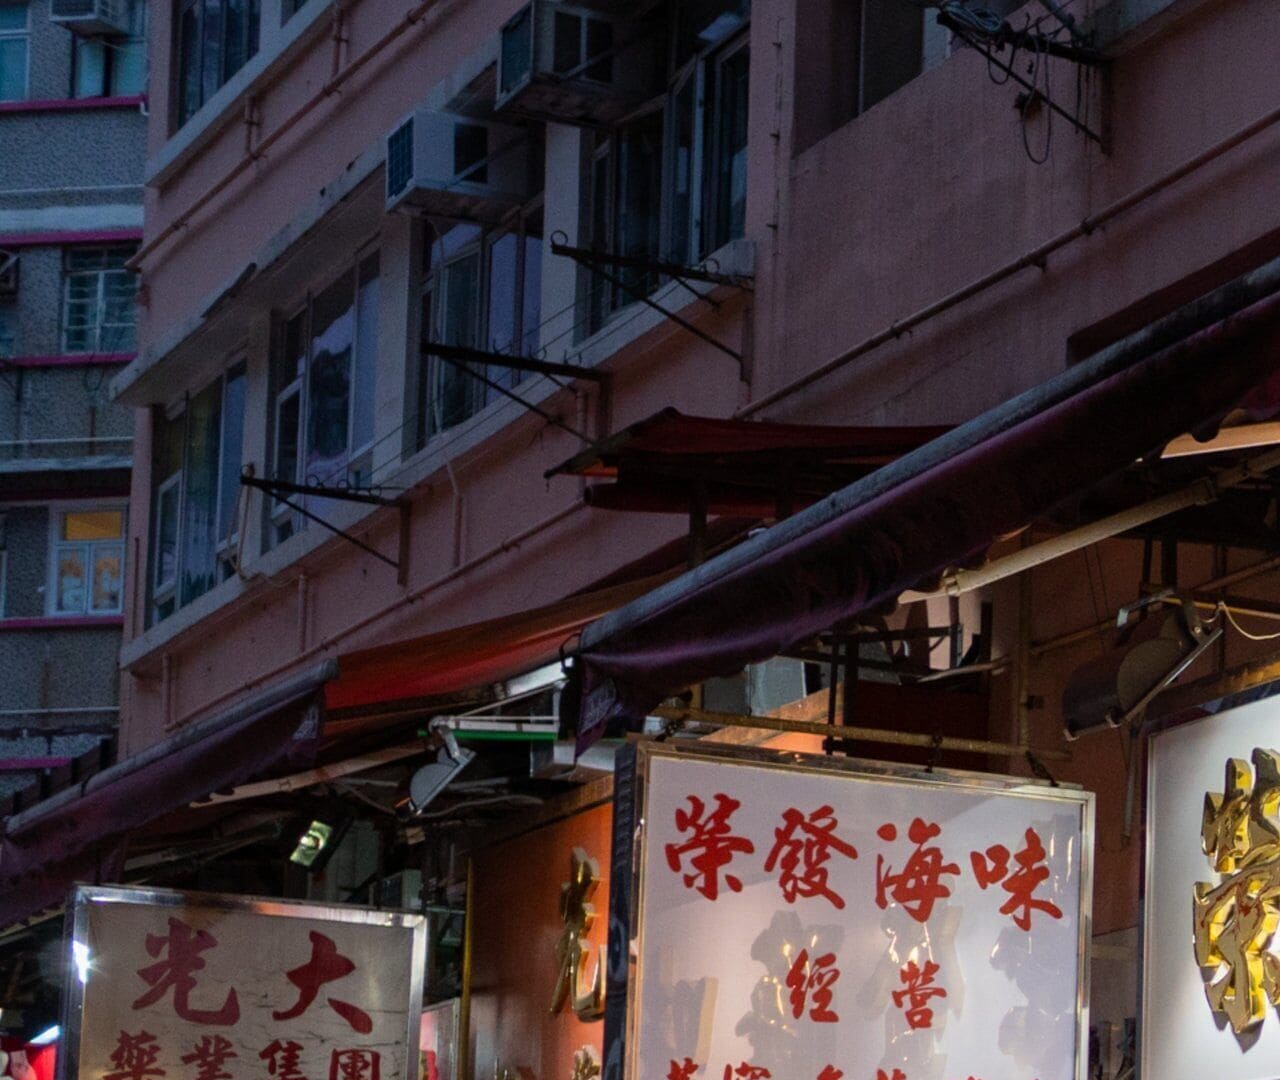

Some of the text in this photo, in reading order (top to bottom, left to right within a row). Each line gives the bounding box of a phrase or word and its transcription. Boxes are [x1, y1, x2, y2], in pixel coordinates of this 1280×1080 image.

[664, 793, 1064, 931] 榮發海味
[133, 917, 373, 1036] 光大
